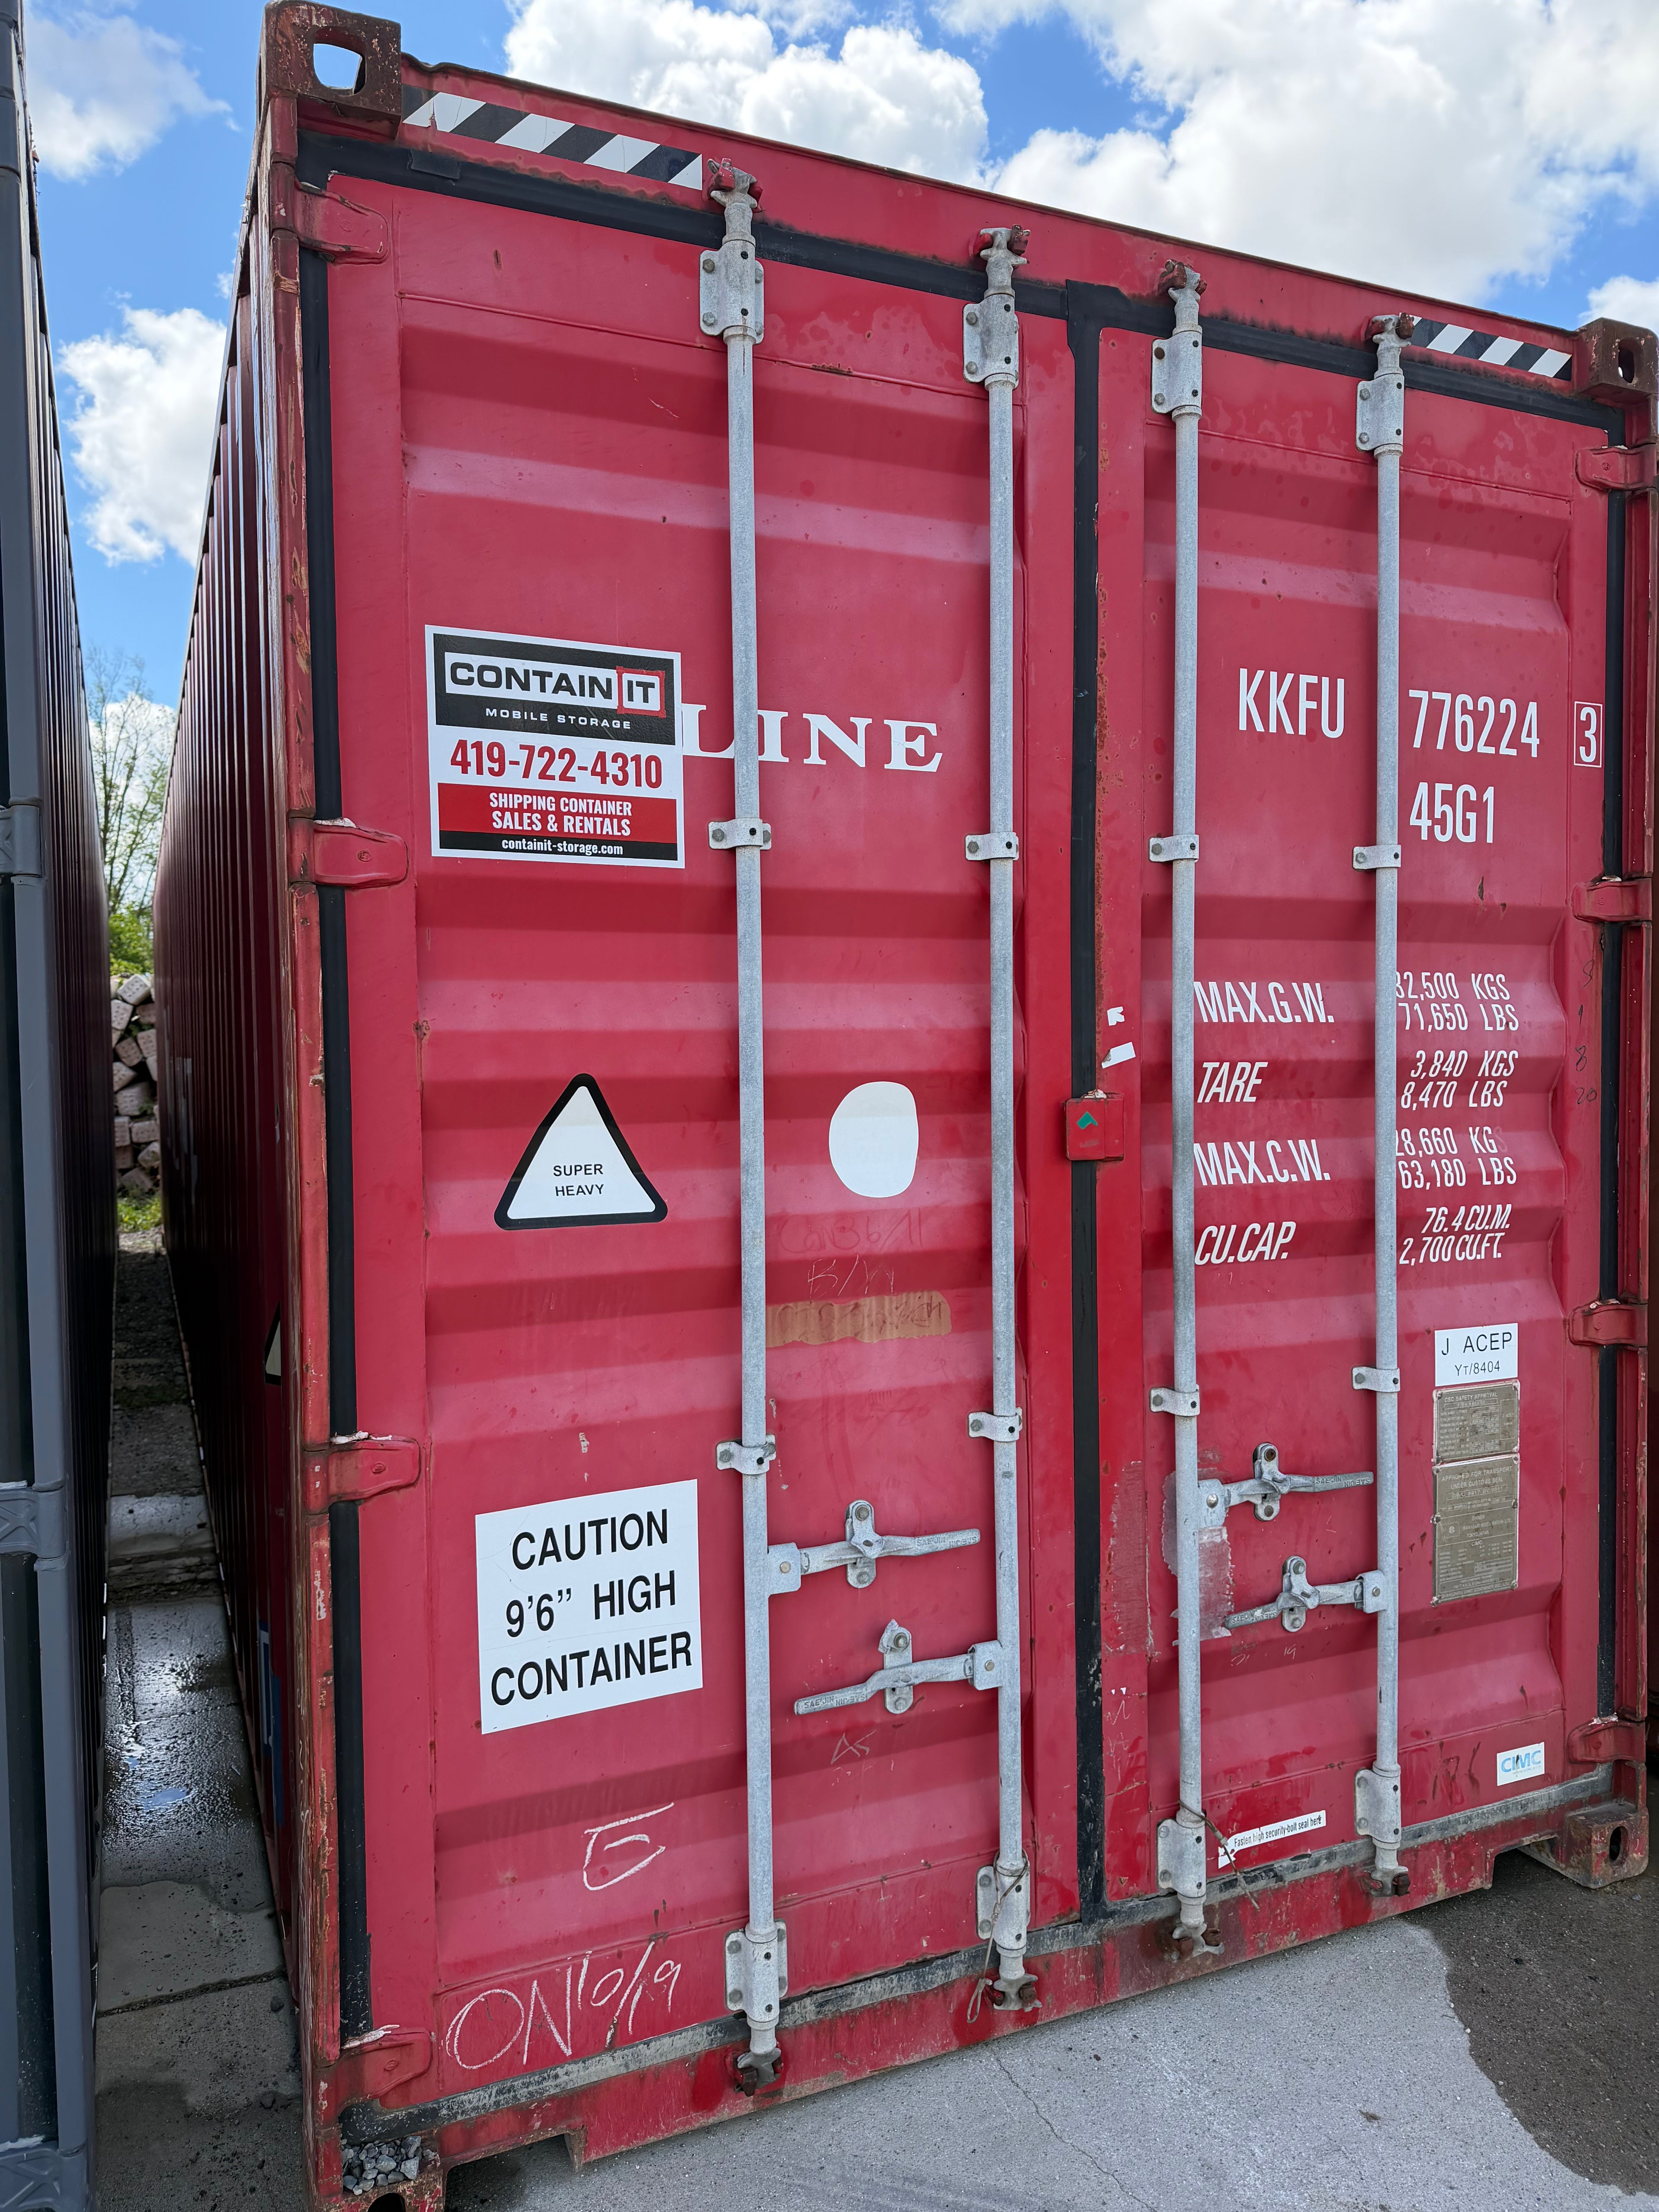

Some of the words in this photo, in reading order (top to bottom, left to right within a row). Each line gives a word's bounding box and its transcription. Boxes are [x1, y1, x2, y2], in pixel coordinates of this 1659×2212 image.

[486, 708, 548, 721] MOBILE
[557, 715, 631, 729] STORAGE
[1239, 668, 1344, 738] KKFU
[1408, 690, 1539, 757] 776224
[1580, 706, 1597, 763] 3
[681, 703, 943, 772] LINE
[450, 739, 662, 788] 419-722-4310
[490, 793, 556, 811] SHIPPING
[560, 797, 632, 816] CONTAINER
[1409, 782, 1494, 843] 45G1
[492, 810, 541, 831] SALES
[547, 816, 558, 832] &
[564, 816, 630, 836] RENTALS
[502, 838, 623, 855] containit-storage.com
[1194, 981, 1335, 1023] MAX.G.W.
[1471, 973, 1510, 1000] KGS
[1398, 1003, 1468, 1032] 71,650
[1479, 1004, 1519, 1030] LBS
[1197, 1062, 1268, 1103] TARE
[1410, 1050, 1468, 1079] 3,840
[1478, 1050, 1519, 1077] KGS
[1401, 1081, 1457, 1111] 8,470
[1469, 1081, 1508, 1107] LBS
[553, 1163, 604, 1177] SUPER
[1194, 1139, 1331, 1186] MAX.C.W.
[1398, 1158, 1466, 1190] 63,180
[1478, 1157, 1516, 1185] LBS
[555, 1184, 604, 1197] HEAVY
[1441, 1338, 1449, 1356] J
[1463, 1332, 1512, 1353] ACEP
[1442, 1472, 1469, 1482] APPROVED
[1484, 1466, 1513, 1476] TRANSPORT
[1451, 1481, 1467, 1490] UNDER
[512, 1508, 667, 1570] CAUTION
[594, 1570, 676, 1620] HIGH
[491, 1631, 692, 1706] CONTAINER
[1501, 1750, 1541, 1773] CIMC
[1298, 1818, 1309, 1830] seal
